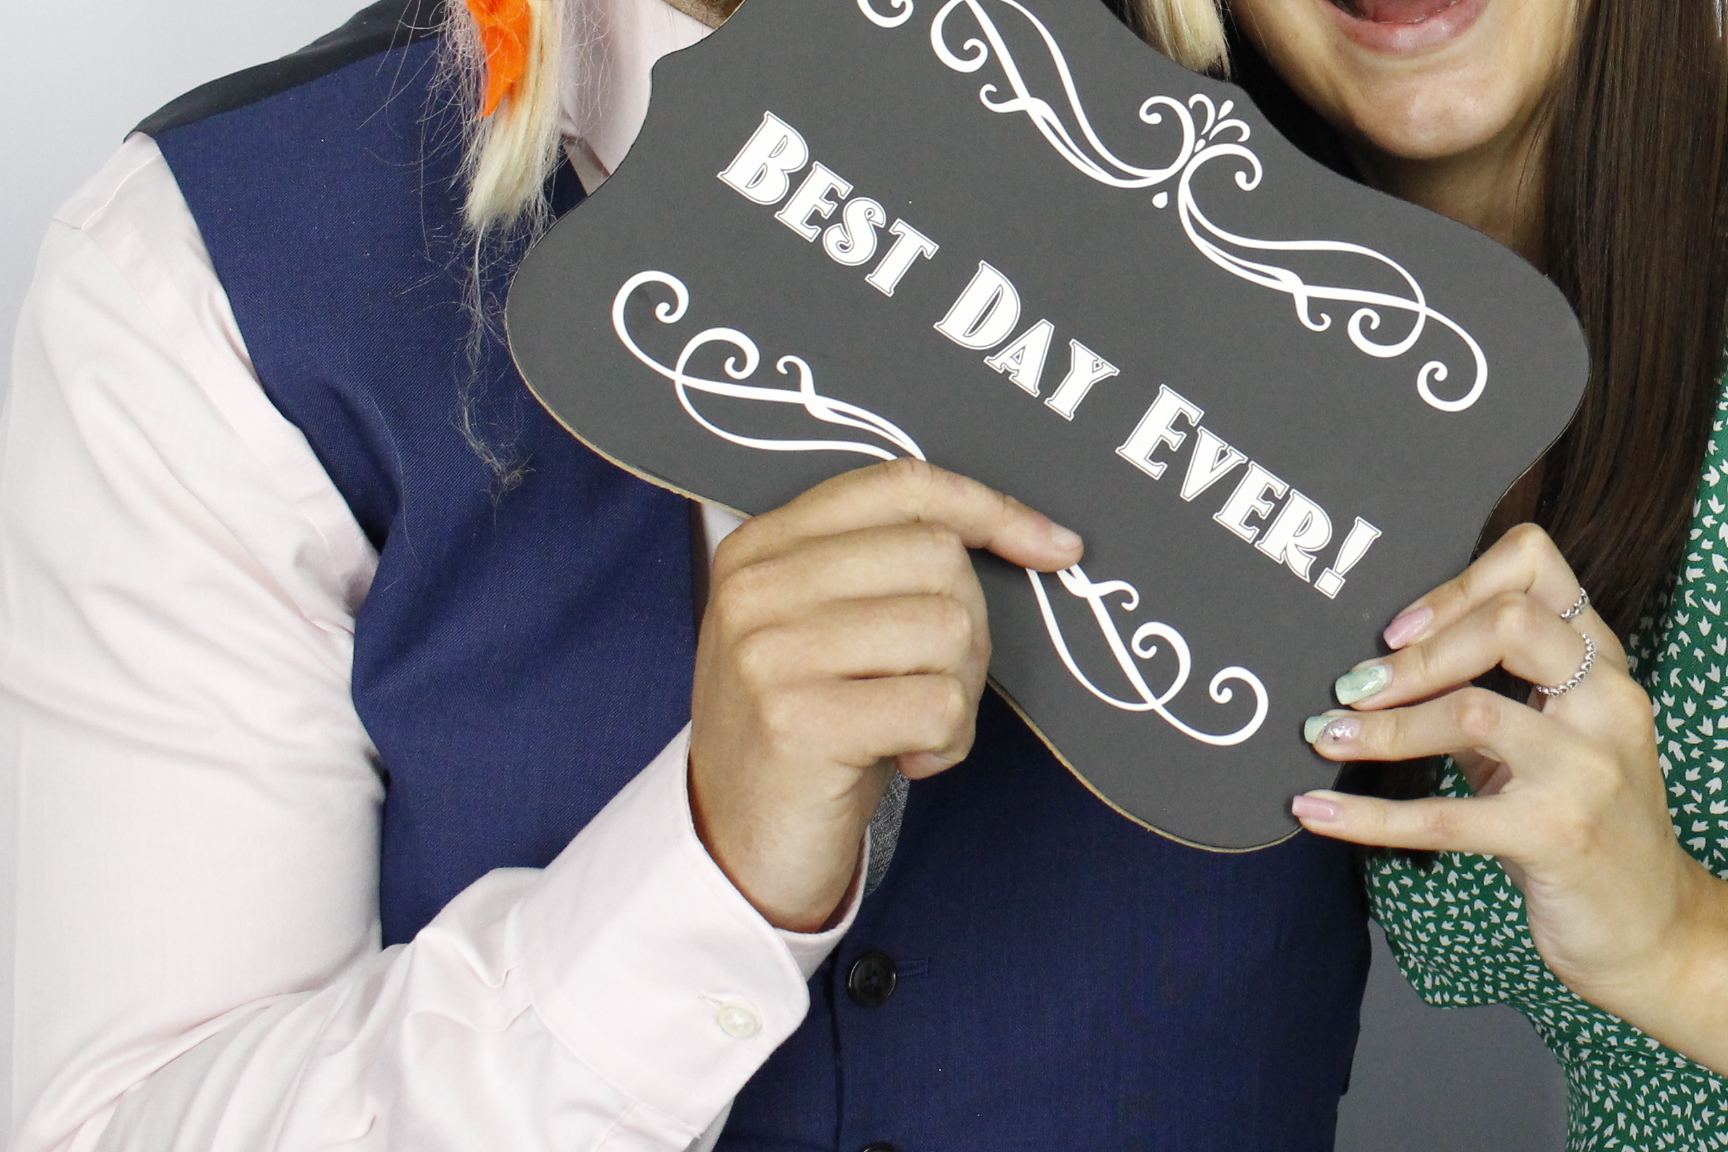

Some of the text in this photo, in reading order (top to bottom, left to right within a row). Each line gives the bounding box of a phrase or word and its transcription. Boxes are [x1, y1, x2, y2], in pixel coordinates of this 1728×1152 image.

[717, 110, 1382, 599] BEST DAY EVER!
